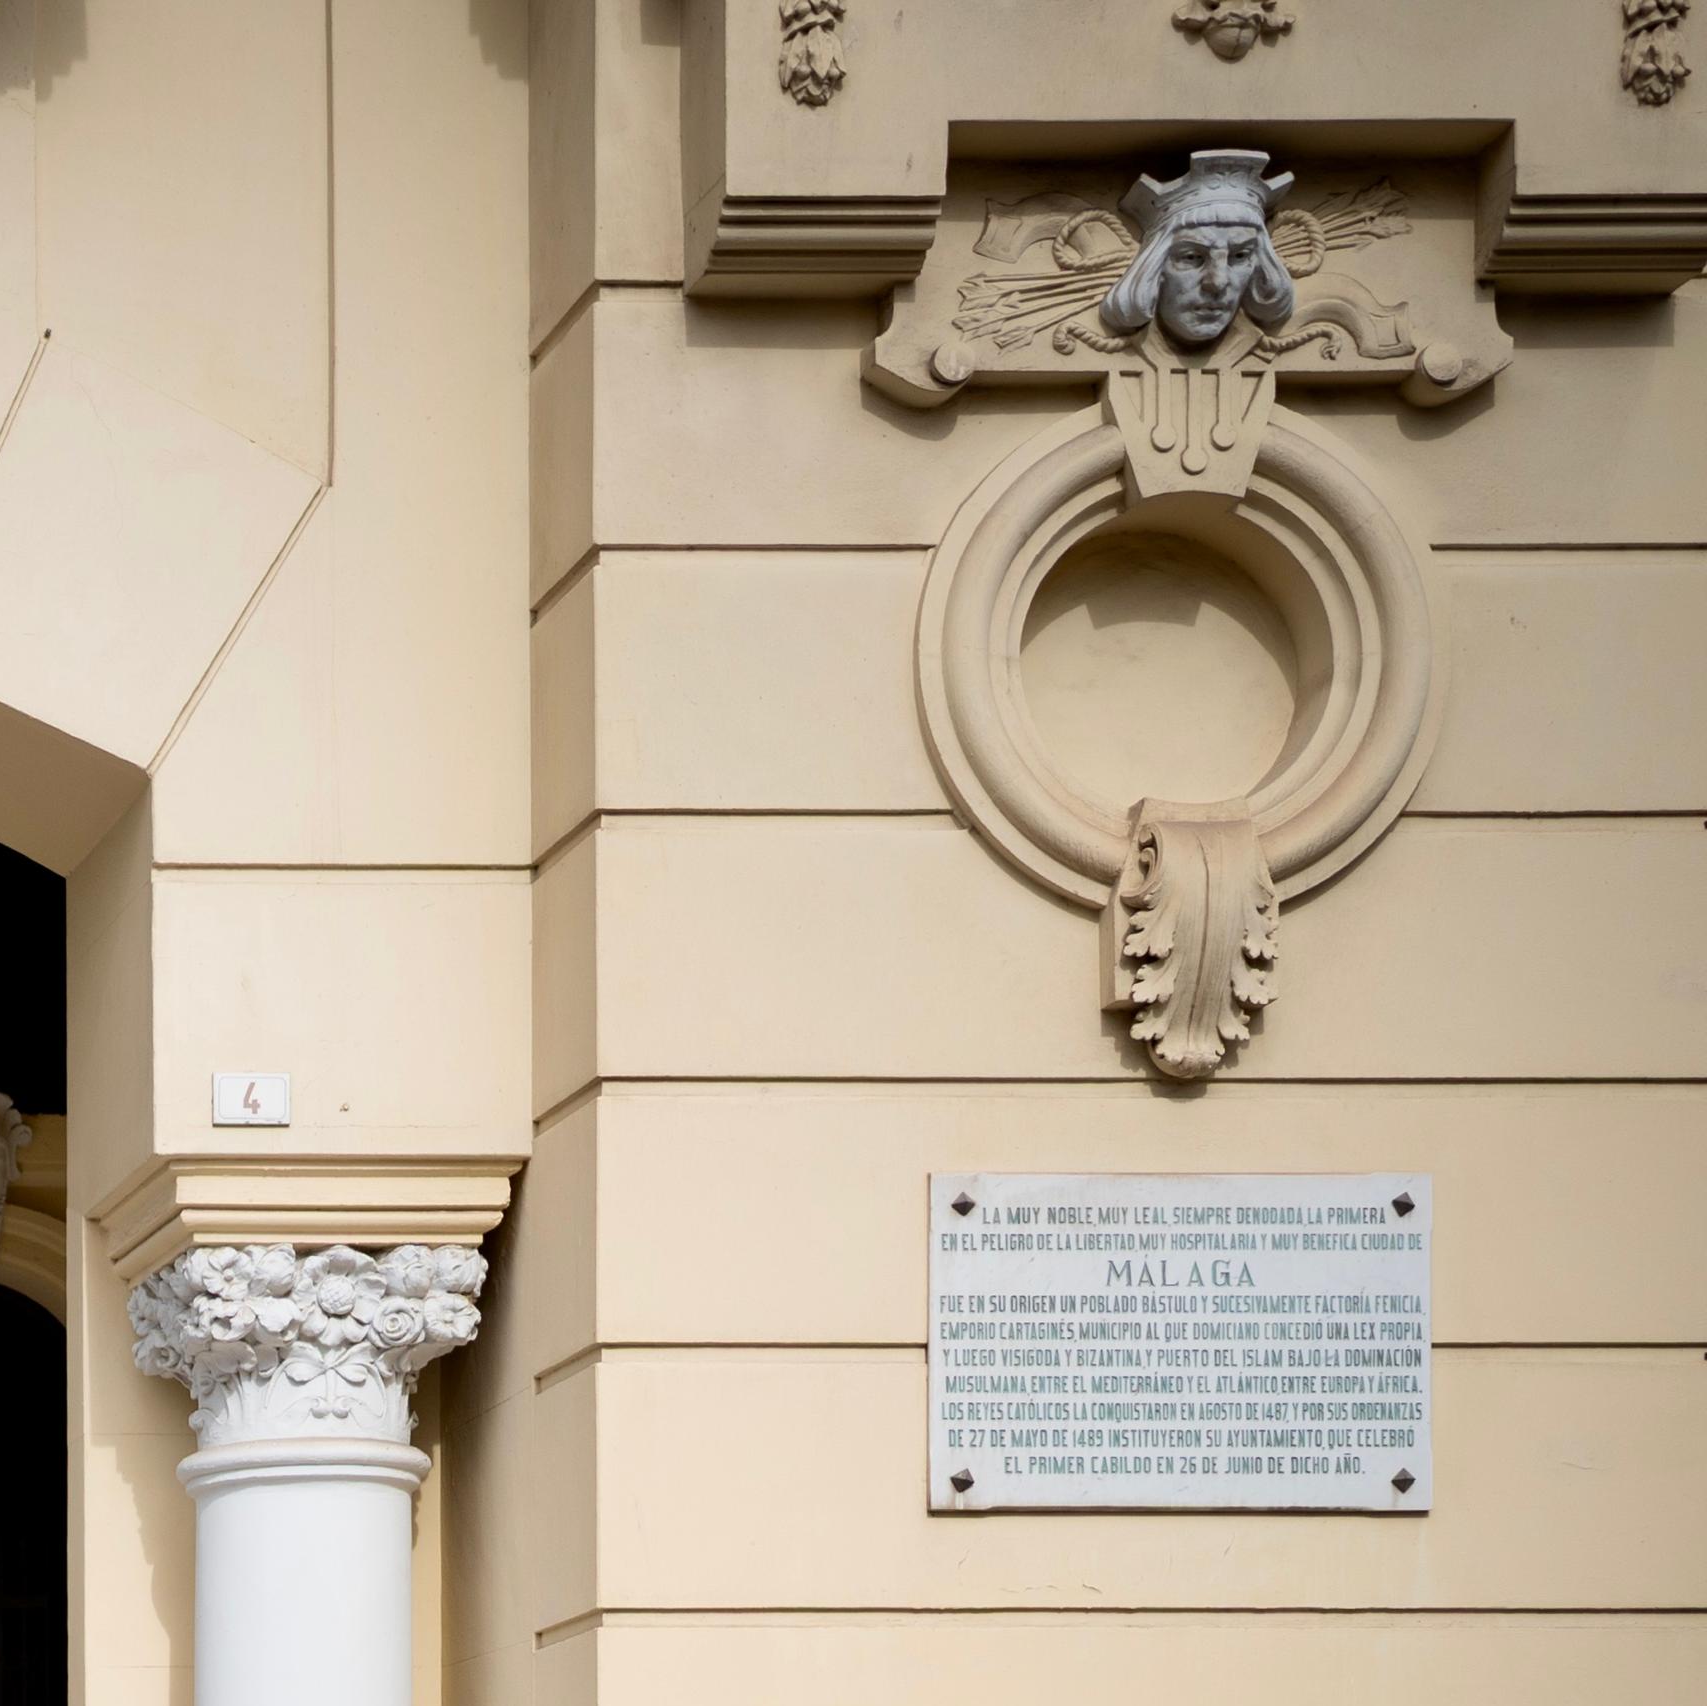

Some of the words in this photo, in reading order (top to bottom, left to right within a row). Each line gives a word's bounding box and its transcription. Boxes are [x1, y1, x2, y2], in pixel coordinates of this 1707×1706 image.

[243, 1082, 261, 1114] 4
[982, 1207, 1001, 1224] LA
[1007, 1207, 1040, 1224] MUY
[1098, 1207, 1128, 1224] MUY
[1173, 1207, 1231, 1224] SIEMPRE
[1308, 1207, 1322, 1224] LA
[1327, 1207, 1385, 1224] PRIMERA
[941, 1234, 958, 1251] EN
[961, 1234, 977, 1251] EL
[981, 1234, 1033, 1251] PELIGRO
[1037, 1234, 1053, 1251] DE
[1057, 1234, 1071, 1251] LA
[1139, 1234, 1166, 1251] MUY
[1171, 1234, 1257, 1251] HOSPITALARIA
[1261, 1234, 1267, 1251] Y
[1271, 1234, 1298, 1251] MUY
[1361, 1234, 1404, 1251] CIUDAD
[1408, 1234, 1422, 1251] DE
[940, 1295, 964, 1313] FUE
[968, 1295, 985, 1313] EN
[989, 1295, 1006, 1313] SU
[1010, 1295, 1056, 1313] ORIGEN
[1060, 1295, 1076, 1313] UN
[1080, 1295, 1137, 1313] POBLADO
[1201, 1295, 1208, 1313] Y
[1212, 1295, 1311, 1313] SUCESIVAMENTE
[940, 1322, 995, 1340] EMPORIO
[1079, 1322, 1141, 1340] MUNICIPIO
[1146, 1322, 1160, 1340] AL
[1165, 1322, 1188, 1342] QUE
[1193, 1322, 1259, 1340] DOMICIANO
[1327, 1322, 1349, 1340] UNA
[1354, 1322, 1375, 1340] LEX
[943, 1349, 950, 1367] Y
[954, 1349, 996, 1367] LUEGO
[1001, 1349, 1060, 1367] VISIGODA
[1065, 1349, 1072, 1367] Y
[1146, 1349, 1152, 1367] Y
[1157, 1349, 1209, 1367] PUERTO
[1214, 1349, 1237, 1367] DEL
[1243, 1349, 1282, 1367] ISLAM
[1288, 1349, 1321, 1367] BAJO
[1031, 1376, 1068, 1393] ENTRE
[1073, 1376, 1087, 1393] EL
[1187, 1376, 1193, 1393] Y
[1197, 1376, 1211, 1393] EL
[1281, 1376, 1316, 1393] ENTRE
[1321, 1376, 1365, 1393] EUROPA
[1368, 1376, 1374, 1393] Y
[942, 1403, 964, 1420] LOS
[968, 1403, 1003, 1420] REYES
[1073, 1403, 1087, 1420] LA
[1091, 1403, 1176, 1422] CONQUISTARON
[1181, 1403, 1195, 1420] EN
[1199, 1403, 1242, 1420] AGOSTO
[1246, 1403, 1259, 1420] DE
[1292, 1403, 1299, 1420] Y
[1302, 1403, 1324, 1420] POR
[1327, 1403, 1348, 1420] SUS
[1352, 1403, 1422, 1420] ORDENANZAS
[948, 1429, 964, 1447] DE
[969, 1429, 986, 1447] 27
[990, 1429, 1006, 1447] DE
[1011, 1429, 1048, 1447] MAYO
[1052, 1429, 1068, 1447] DE
[1073, 1429, 1103, 1447] 1489
[1109, 1429, 1201, 1447] INSTITUYERON
[1206, 1429, 1222, 1447] SU
[1328, 1429, 1352, 1449] QUE
[1004, 1457, 1023, 1474] EL
[1029, 1457, 1084, 1474] PRIMER
[1091, 1457, 1152, 1474] CABILDO
[1157, 1457, 1174, 1474] EN
[1180, 1457, 1197, 1474] 26
[1202, 1457, 1218, 1474] DE
[1224, 1457, 1263, 1474] JUNIO
[1267, 1457, 1285, 1474] DE
[1291, 1457, 1329, 1474] DICHO
[1335, 1453, 1365, 1474] AÑO.
